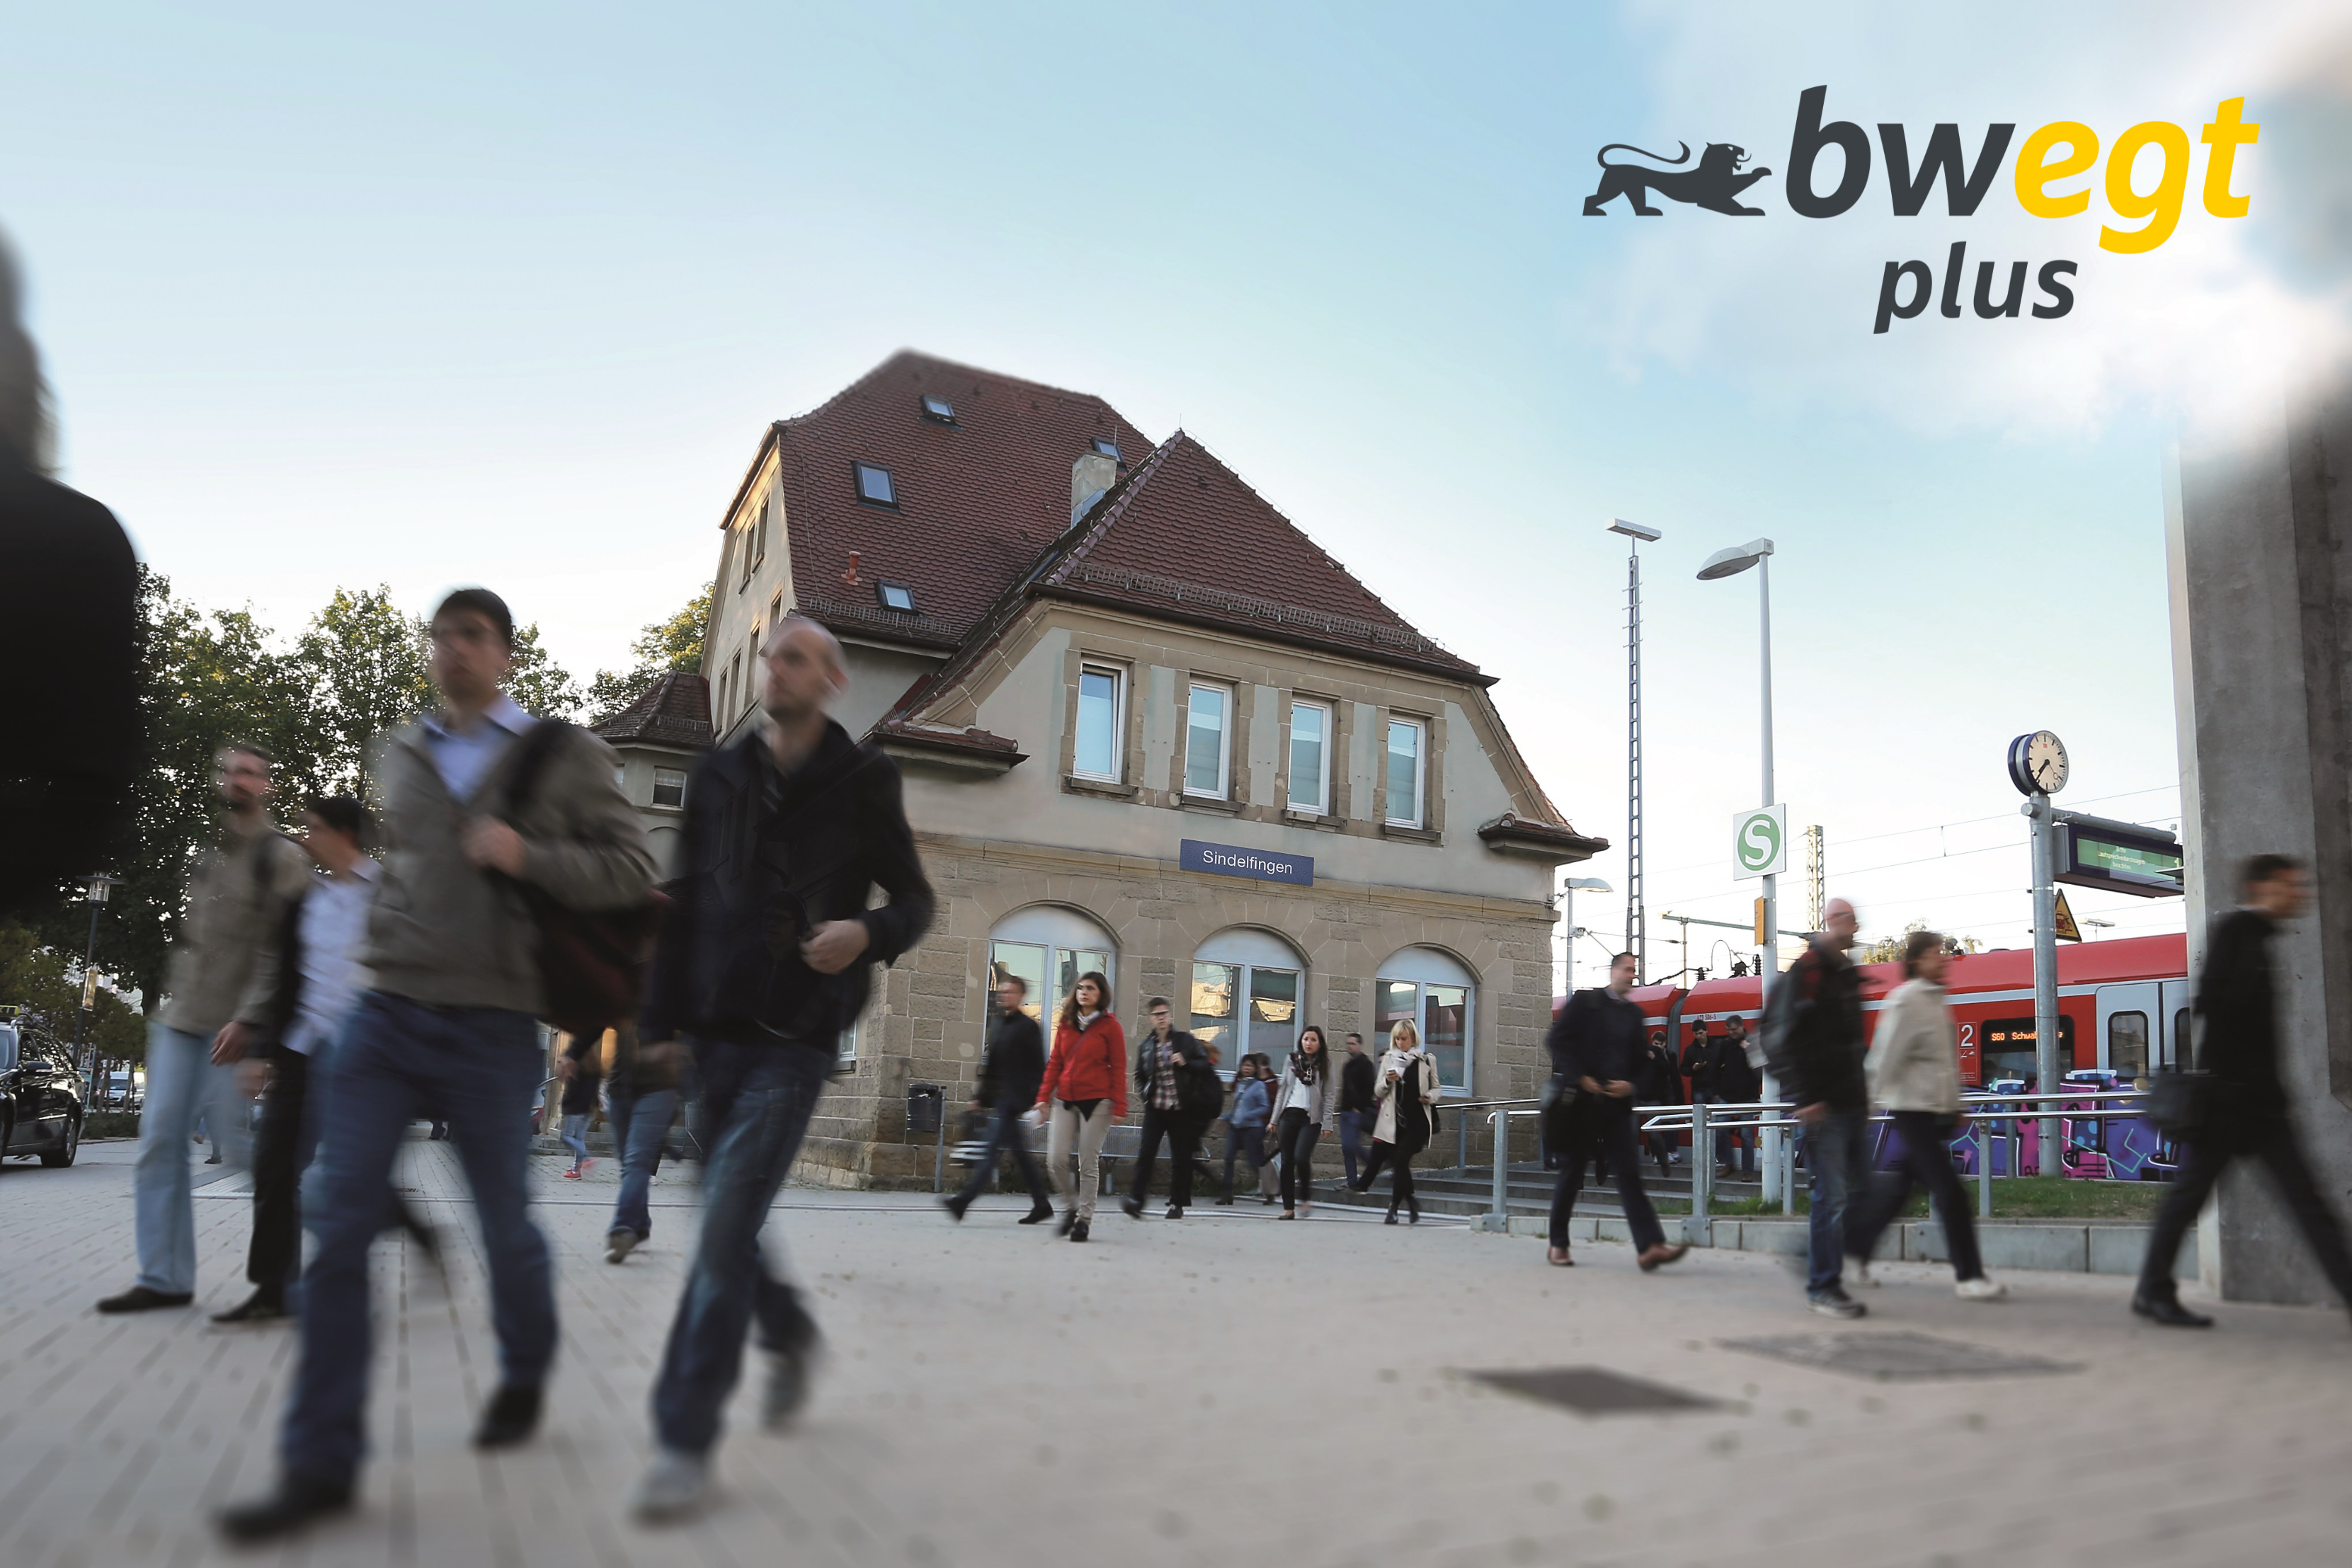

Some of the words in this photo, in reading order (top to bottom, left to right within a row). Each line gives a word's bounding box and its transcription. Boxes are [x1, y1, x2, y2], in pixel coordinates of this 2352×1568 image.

[1745, 820, 1773, 866] S
[1203, 850, 1293, 875] Sindelfingen
[1961, 1024, 1973, 1046] 2
[1991, 1032, 2005, 1041] S60
